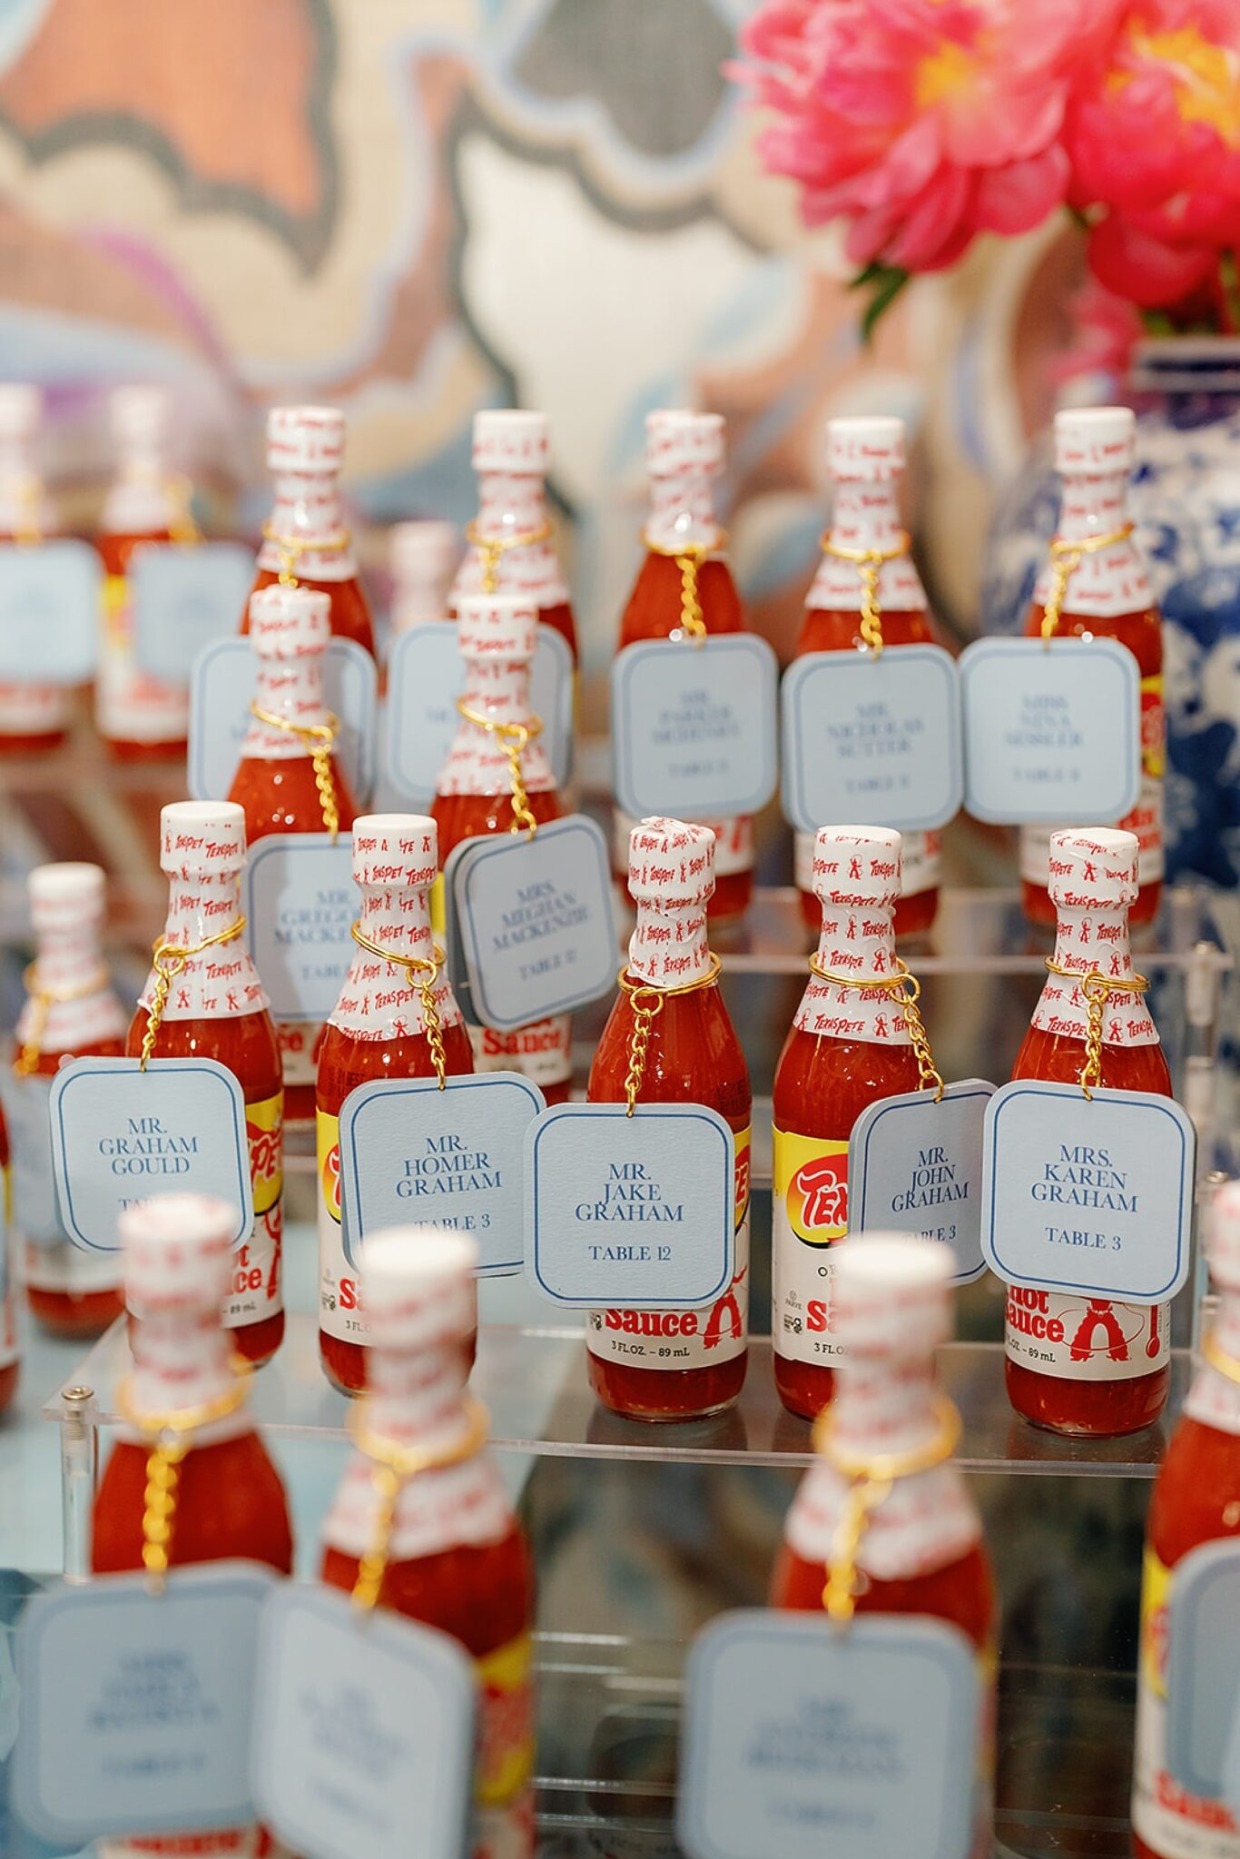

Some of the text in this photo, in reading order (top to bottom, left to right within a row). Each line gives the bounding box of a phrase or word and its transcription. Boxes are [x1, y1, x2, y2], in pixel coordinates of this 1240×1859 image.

[127, 1116, 168, 1136] MR.
[99, 1136, 199, 1156] GRAHAM
[426, 1134, 468, 1156] MR.
[111, 1157, 190, 1176] GOULD
[403, 1152, 492, 1178] HOMER
[918, 1146, 949, 1168] MR.
[1060, 1144, 1113, 1169] MRS.
[608, 1163, 652, 1182] MR.
[908, 1164, 957, 1194] JOHN
[1044, 1163, 1128, 1190] KAREN
[396, 1170, 503, 1199] GRAHAM
[600, 1183, 663, 1206] JAKE
[797, 1171, 849, 1229] TEX
[891, 1181, 970, 1214] GRAHAM
[1031, 1183, 1140, 1214] GRAHAM
[481, 1213, 492, 1230] 3
[575, 1203, 685, 1223] GRAHAM
[948, 1224, 957, 1241] 3
[1045, 1227, 1122, 1252] TABLE 3
[588, 1245, 672, 1262] TABLE 12
[605, 1308, 698, 1338] Sauce
[611, 1340, 617, 1350] 3
[658, 1347, 671, 1358] 89
[673, 1347, 690, 1358] mL
[814, 1342, 821, 1353] 3
[1028, 1347, 1039, 1359] 89
[1040, 1352, 1056, 1363] mL
